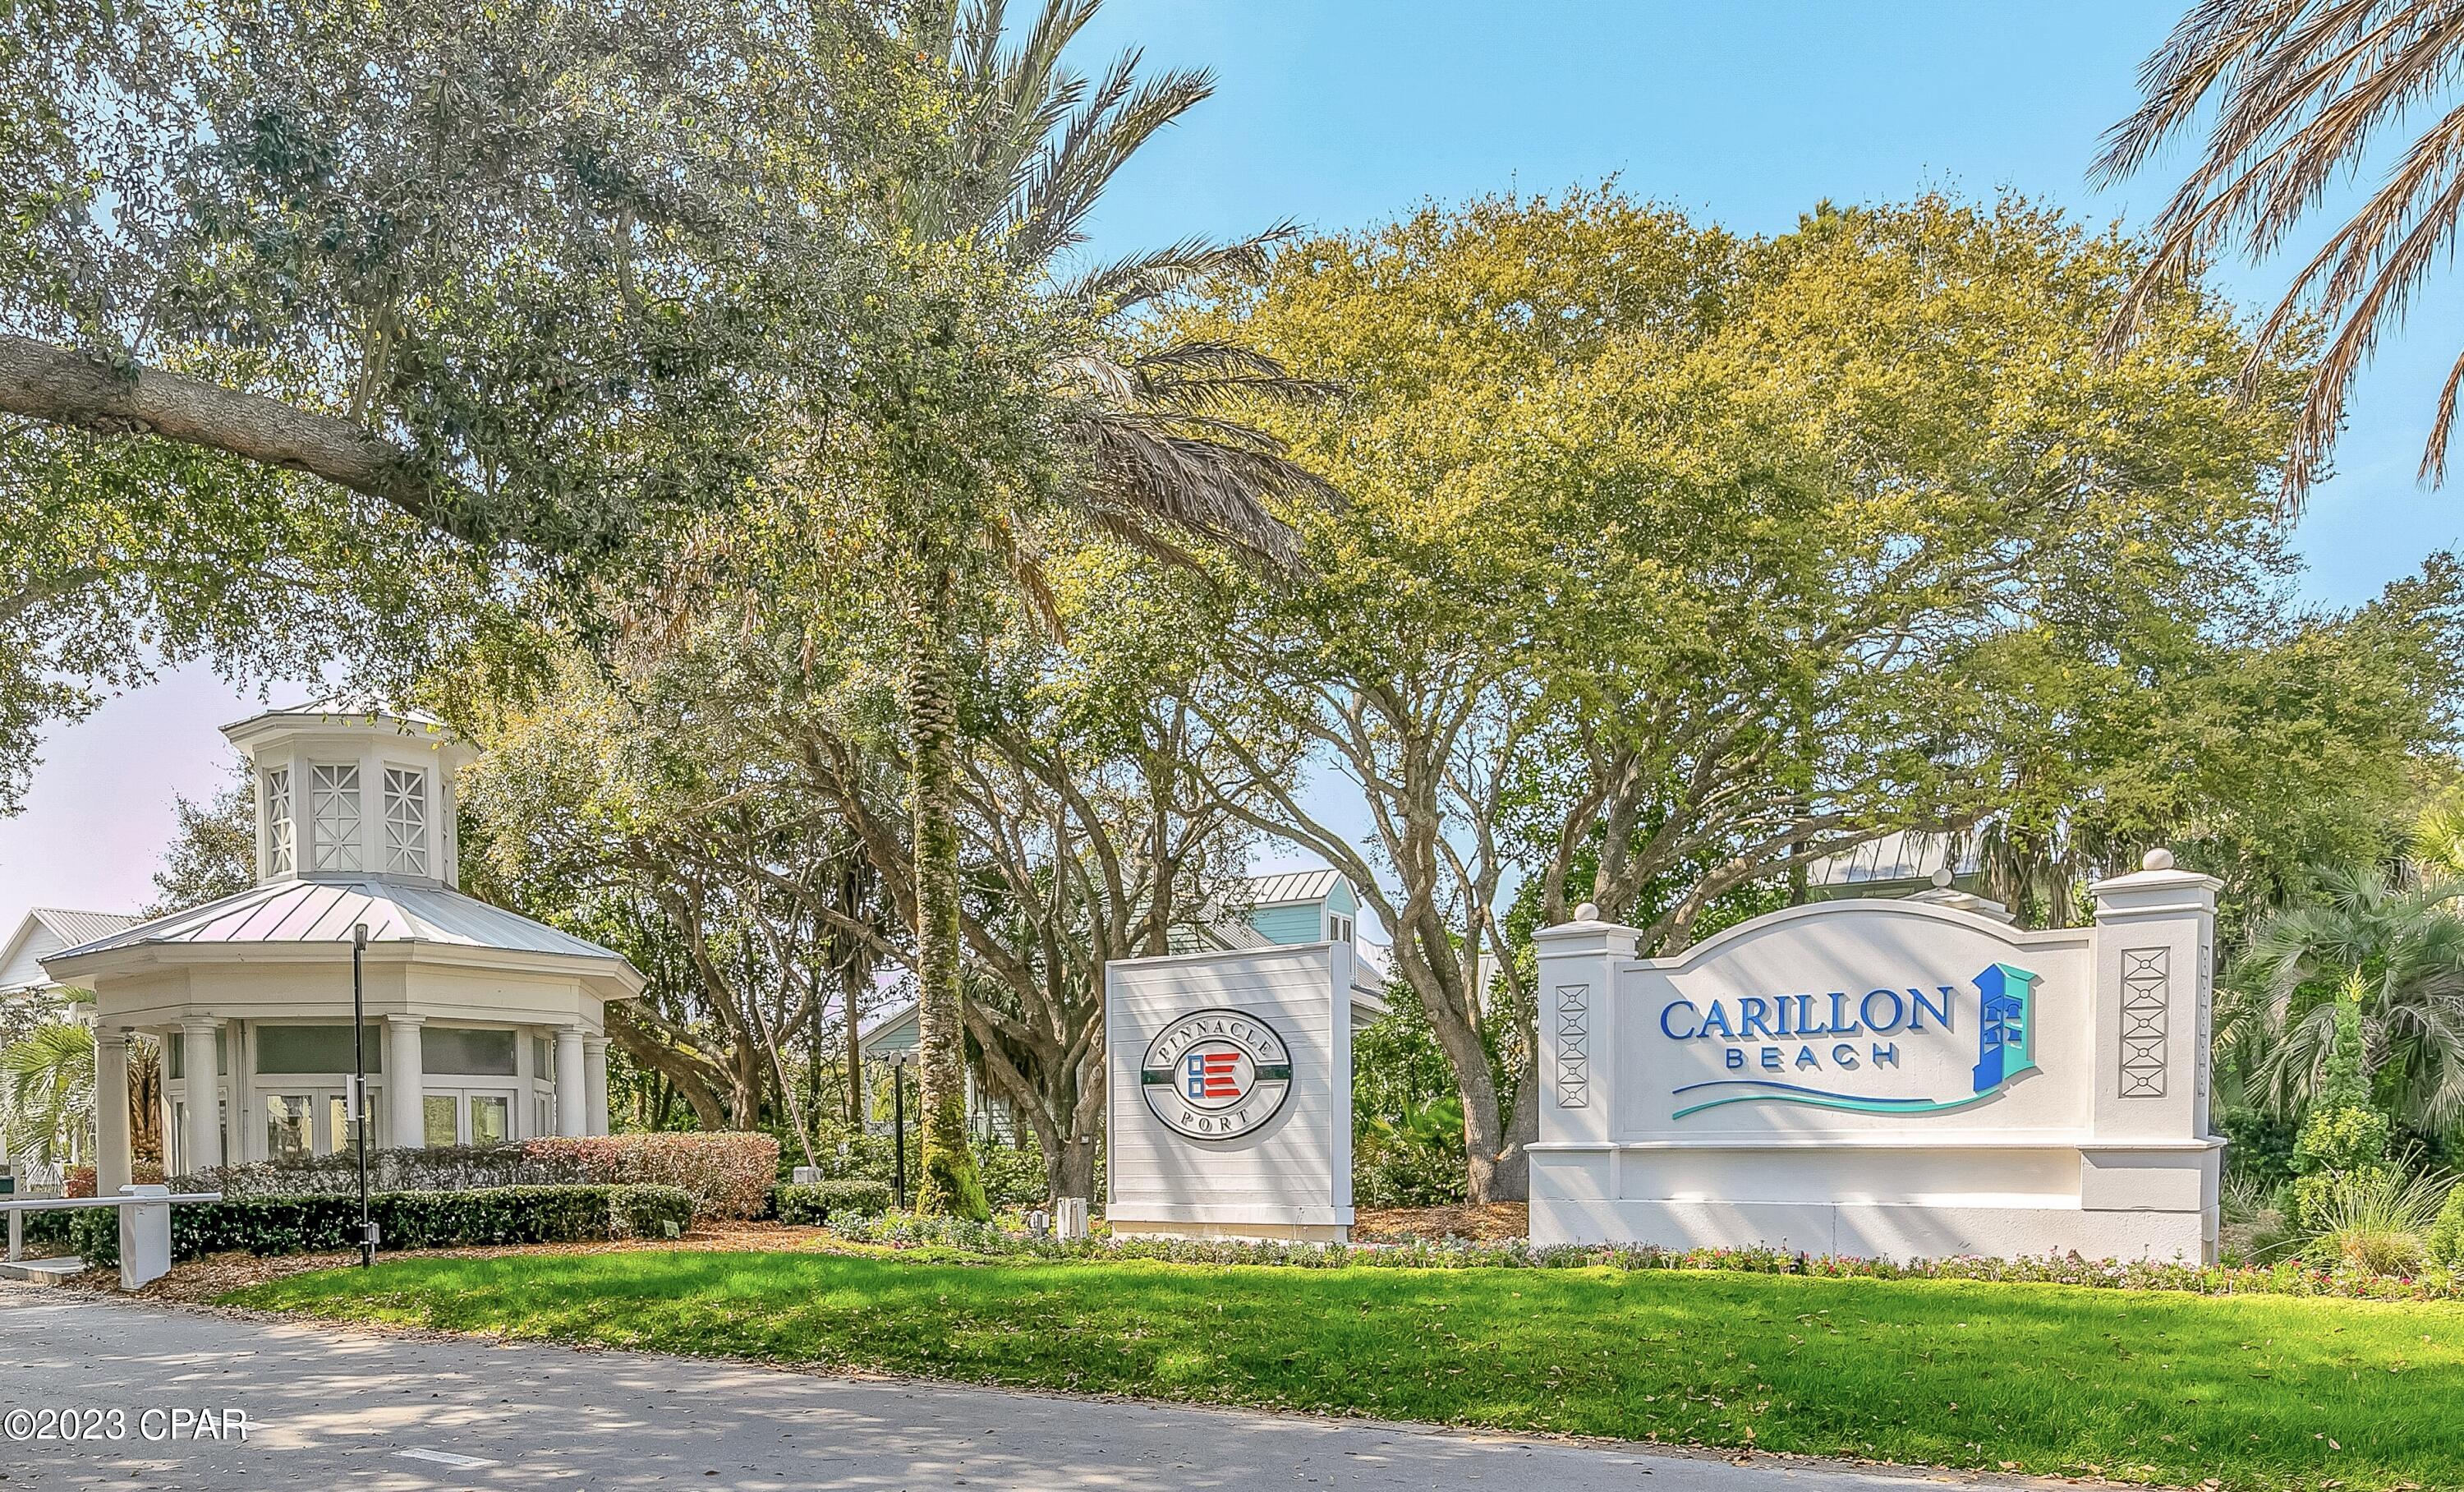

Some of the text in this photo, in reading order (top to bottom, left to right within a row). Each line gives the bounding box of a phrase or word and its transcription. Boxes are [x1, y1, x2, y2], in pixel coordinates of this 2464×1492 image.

[1660, 986, 1953, 1040] CARILLON
[1158, 1019, 1272, 1062] PINNACLE
[1726, 1042, 1896, 1069] BEACH
[1180, 1108, 1249, 1132] PORT
